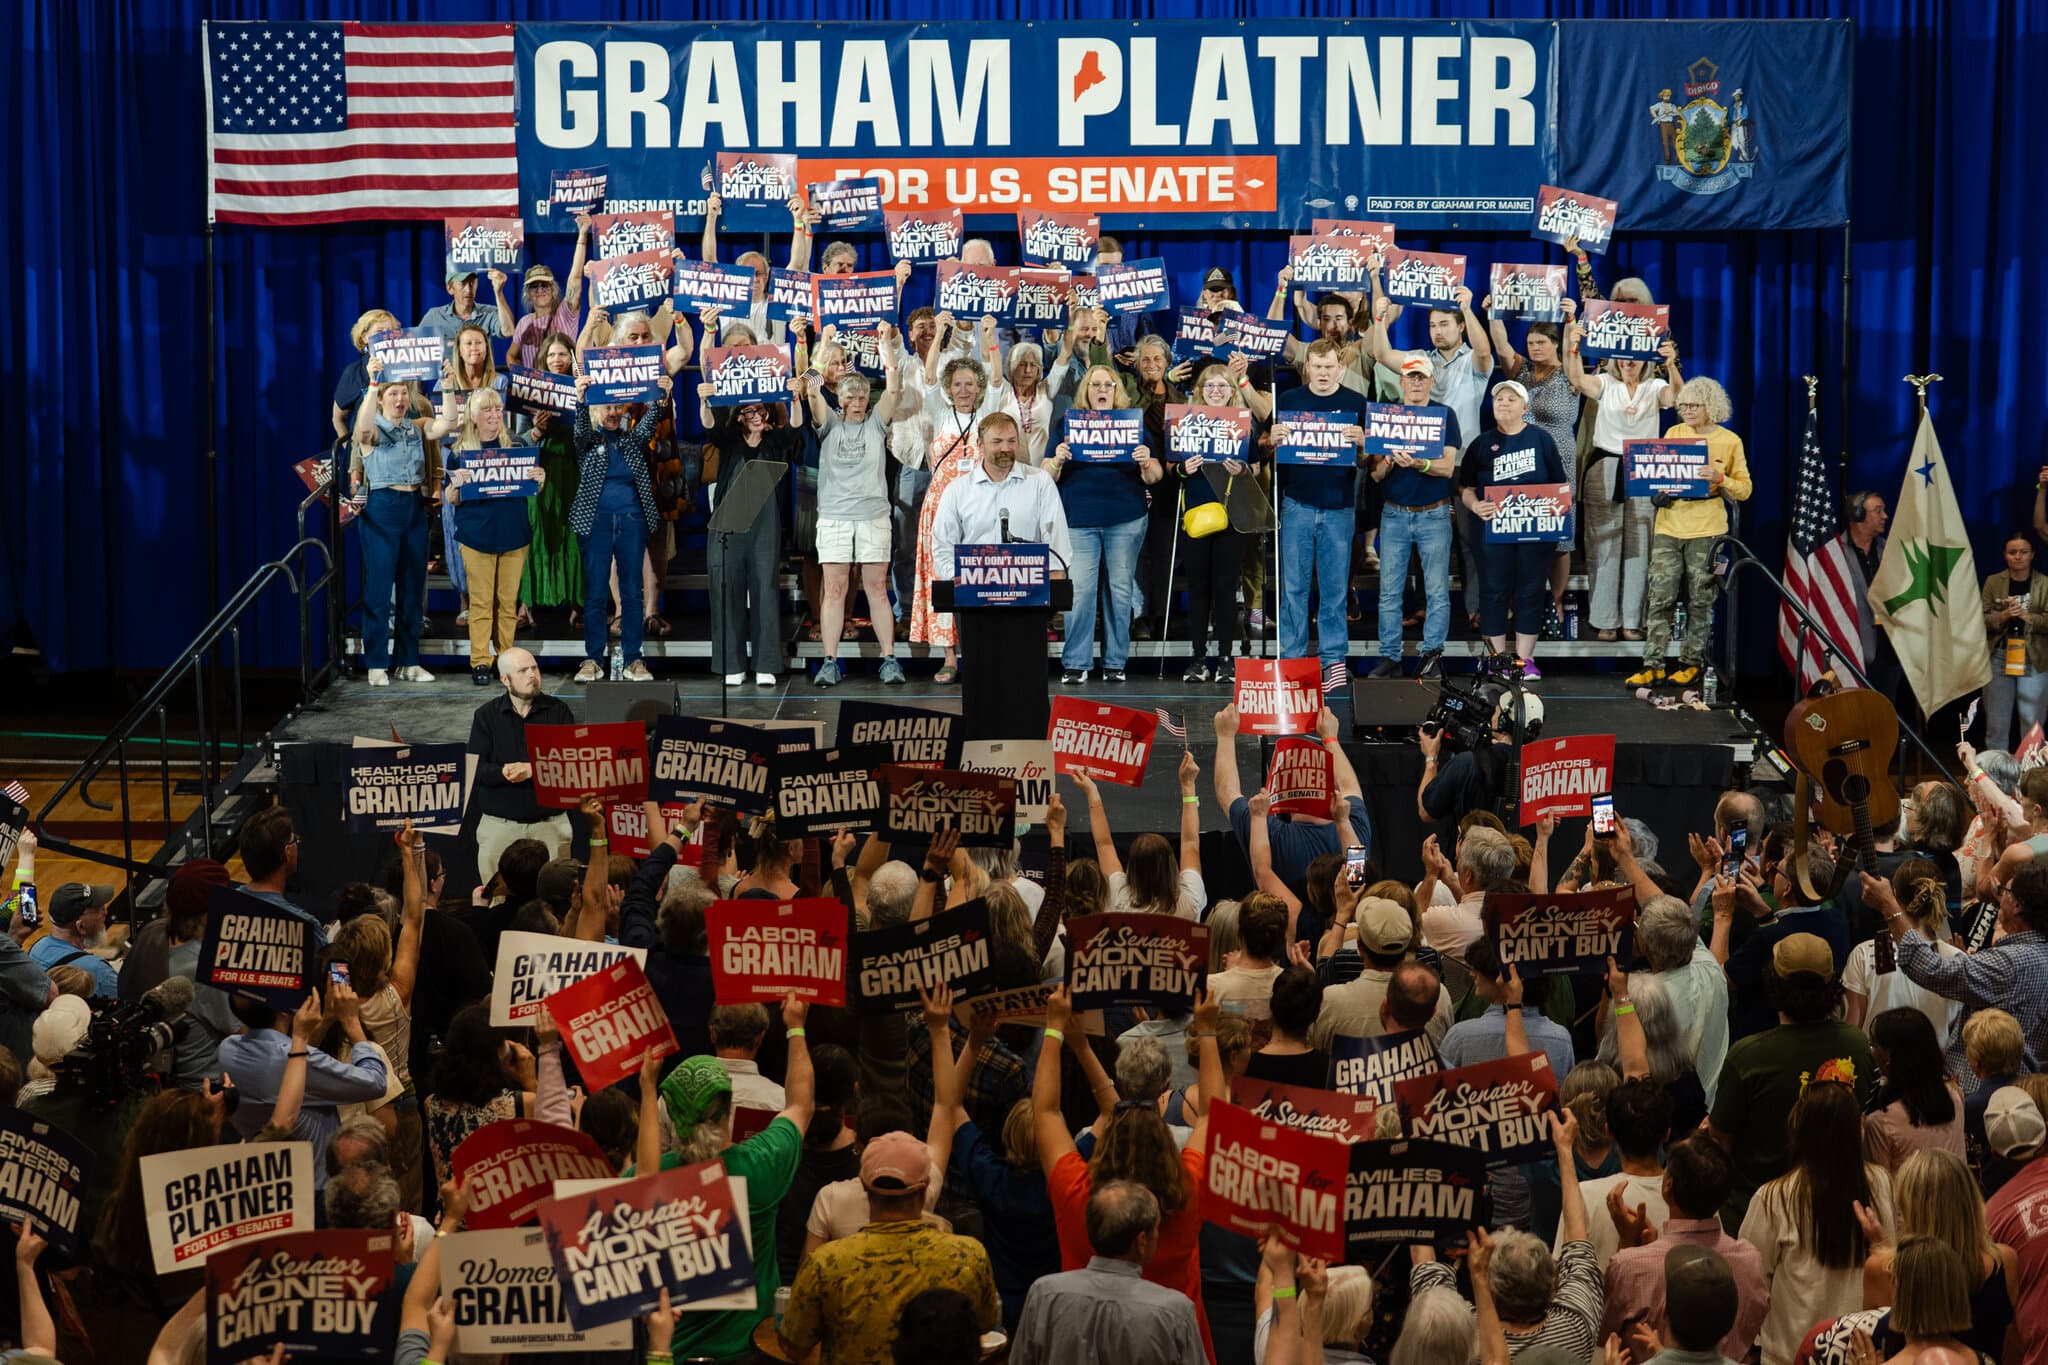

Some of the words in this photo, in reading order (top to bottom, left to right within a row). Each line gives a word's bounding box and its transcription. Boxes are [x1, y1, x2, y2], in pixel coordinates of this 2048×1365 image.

[534, 38, 1010, 149] GRAHAM
[1058, 36, 1536, 146] PLATNER
[722, 172, 791, 185] MONEY
[946, 168, 1032, 204] U.S.
[1048, 166, 1236, 203] SENATE
[555, 184, 606, 202] MAINE
[722, 184, 761, 198] CAN'T
[764, 185, 791, 200] BUY
[1371, 201, 1392, 209] PAID
[1395, 201, 1413, 209] FOR
[1416, 201, 1428, 209] BY
[1432, 201, 1474, 209] GRAHAM
[1477, 201, 1493, 209] FOR
[1498, 201, 1529, 209] MAINE
[1541, 205, 1608, 229] MONEY
[452, 239, 518, 249] MONEY
[891, 230, 957, 243] MONEY
[1025, 230, 1092, 246] MONEY
[453, 249, 491, 264] CAN'T
[494, 249, 518, 264] BUY
[892, 243, 931, 258] CAN'T
[934, 239, 959, 256] BUY
[1025, 242, 1066, 261] CAN'T
[1070, 246, 1092, 263] BUY
[1295, 256, 1364, 267] MONEY
[597, 269, 667, 293] MONEY
[1294, 267, 1334, 282] CAN'T
[1337, 268, 1364, 282] BUY
[1389, 270, 1456, 286] MONEY
[600, 287, 639, 306] CAN'T
[643, 279, 670, 298] BUY
[679, 280, 748, 300] MAINE
[941, 284, 1012, 298] MONEY
[1101, 278, 1165, 300] MAINE
[1389, 281, 1427, 297] CAN'T
[1430, 286, 1456, 300] BUY
[824, 296, 894, 314] MAINE
[940, 297, 980, 312] CAN'T
[984, 298, 1011, 312] BUY
[1588, 321, 1660, 336] MONEY
[1587, 332, 1628, 350] CAN'T
[1632, 335, 1660, 351] BUY
[376, 346, 442, 364] MAINE
[590, 366, 660, 384] MAINE
[712, 366, 784, 380] MONEY
[714, 379, 754, 395] CAN'T
[758, 377, 786, 393] BUY
[511, 385, 577, 410] MAINE
[1178, 414, 1194, 427] A
[1196, 414, 1238, 428] Senator
[1069, 428, 1139, 444] MAINE
[1170, 426, 1243, 439] MONEY
[1283, 431, 1352, 447] MAINE
[1371, 422, 1441, 441] MAINE
[1170, 438, 1211, 454] CAN'T
[1214, 440, 1242, 455] BUY
[1494, 448, 1535, 466] GRAHAM
[1494, 457, 1535, 475] PLATNER
[468, 466, 535, 483] MAINE
[1635, 463, 1702, 479] MAINE
[1499, 495, 1516, 507] A
[1517, 494, 1559, 506] Senator
[1493, 505, 1564, 518] MONEY
[1492, 518, 1534, 534] CAN'T
[1537, 515, 1565, 532] BUY
[960, 556, 982, 566] THEY
[985, 556, 1011, 565] DON'T
[1014, 556, 1044, 565] KNOW
[961, 568, 1044, 584] MAINE
[1241, 680, 1300, 690] EDUCATORS
[1238, 688, 1318, 714] GRAHAM
[852, 718, 952, 744] GRAHAM
[1056, 718, 1132, 738] EDUCATORS
[536, 747, 612, 761] LABOR
[661, 739, 747, 760] SENIORS
[1052, 727, 1146, 767] GRAHAM
[351, 766, 412, 777] HEALTH
[415, 763, 457, 774] CARE
[535, 758, 644, 789] GRAHAM
[655, 751, 768, 794] GRAHAM
[1525, 758, 1591, 776] EDUCATORS
[357, 774, 438, 786] WORKERS
[781, 768, 868, 788] FAMILIES
[1523, 767, 1607, 803] GRAHAM
[349, 782, 460, 815] GRAHAM
[902, 781, 926, 796] A
[930, 781, 997, 800] Senator
[889, 794, 1005, 815] MONEY
[889, 809, 954, 833] CAN'T
[960, 814, 1005, 835] BUY
[1513, 906, 1538, 923] A
[1541, 905, 1614, 922] Senator
[220, 914, 304, 947] GRAHAM
[726, 927, 816, 944] LABOR
[1500, 916, 1622, 939] MONEY
[1086, 928, 1109, 949] A
[1114, 926, 1189, 950] Senator
[1500, 935, 1568, 964] CAN'T
[1575, 932, 1622, 957] BUY
[214, 941, 303, 974] PLATNER
[862, 934, 961, 969] FAMILIES
[1072, 950, 1199, 968] MONEY
[722, 943, 841, 981] GRAHAM
[860, 938, 989, 997] GRAHAM
[219, 972, 238, 981] FOR
[240, 974, 256, 983] U.S.
[258, 975, 295, 986] SENATE
[1071, 966, 1143, 994] CAN'T
[1150, 966, 1199, 997] BUY
[1336, 1033, 1434, 1086] GRAHAM
[1423, 1089, 1449, 1116] A
[1454, 1080, 1534, 1108] Senator
[1251, 1098, 1275, 1118] A
[1271, 1100, 1352, 1133] Senator
[1412, 1092, 1546, 1137] MONEY
[0, 1129, 70, 1173] RMERS
[70, 1166, 80, 1182] &
[0, 1144, 60, 1182] SHERS
[464, 1143, 578, 1178] EDUCATORS
[1214, 1133, 1300, 1185] LABOR
[1304, 1169, 1333, 1191] for
[165, 1148, 292, 1211] GRAHAM
[468, 1152, 613, 1213] GRAHAM
[0, 1161, 80, 1233] AHAM
[1209, 1154, 1337, 1234] GRAHAM
[1343, 1182, 1474, 1220] RAHAM
[169, 1181, 293, 1245] PLATNER
[579, 1210, 608, 1245] A
[611, 1196, 707, 1233] Senator
[184, 1242, 208, 1257] FOR
[210, 1230, 233, 1247] U.S.
[236, 1217, 283, 1237] SENATE
[565, 1209, 721, 1272] MONEY
[233, 1258, 262, 1290] A
[266, 1252, 366, 1279] Senator
[572, 1253, 664, 1306] CAN'T
[669, 1233, 733, 1281] BUY
[217, 1277, 378, 1316] MONEY
[217, 1300, 304, 1348] CAN'T
[313, 1301, 378, 1334] BUY
